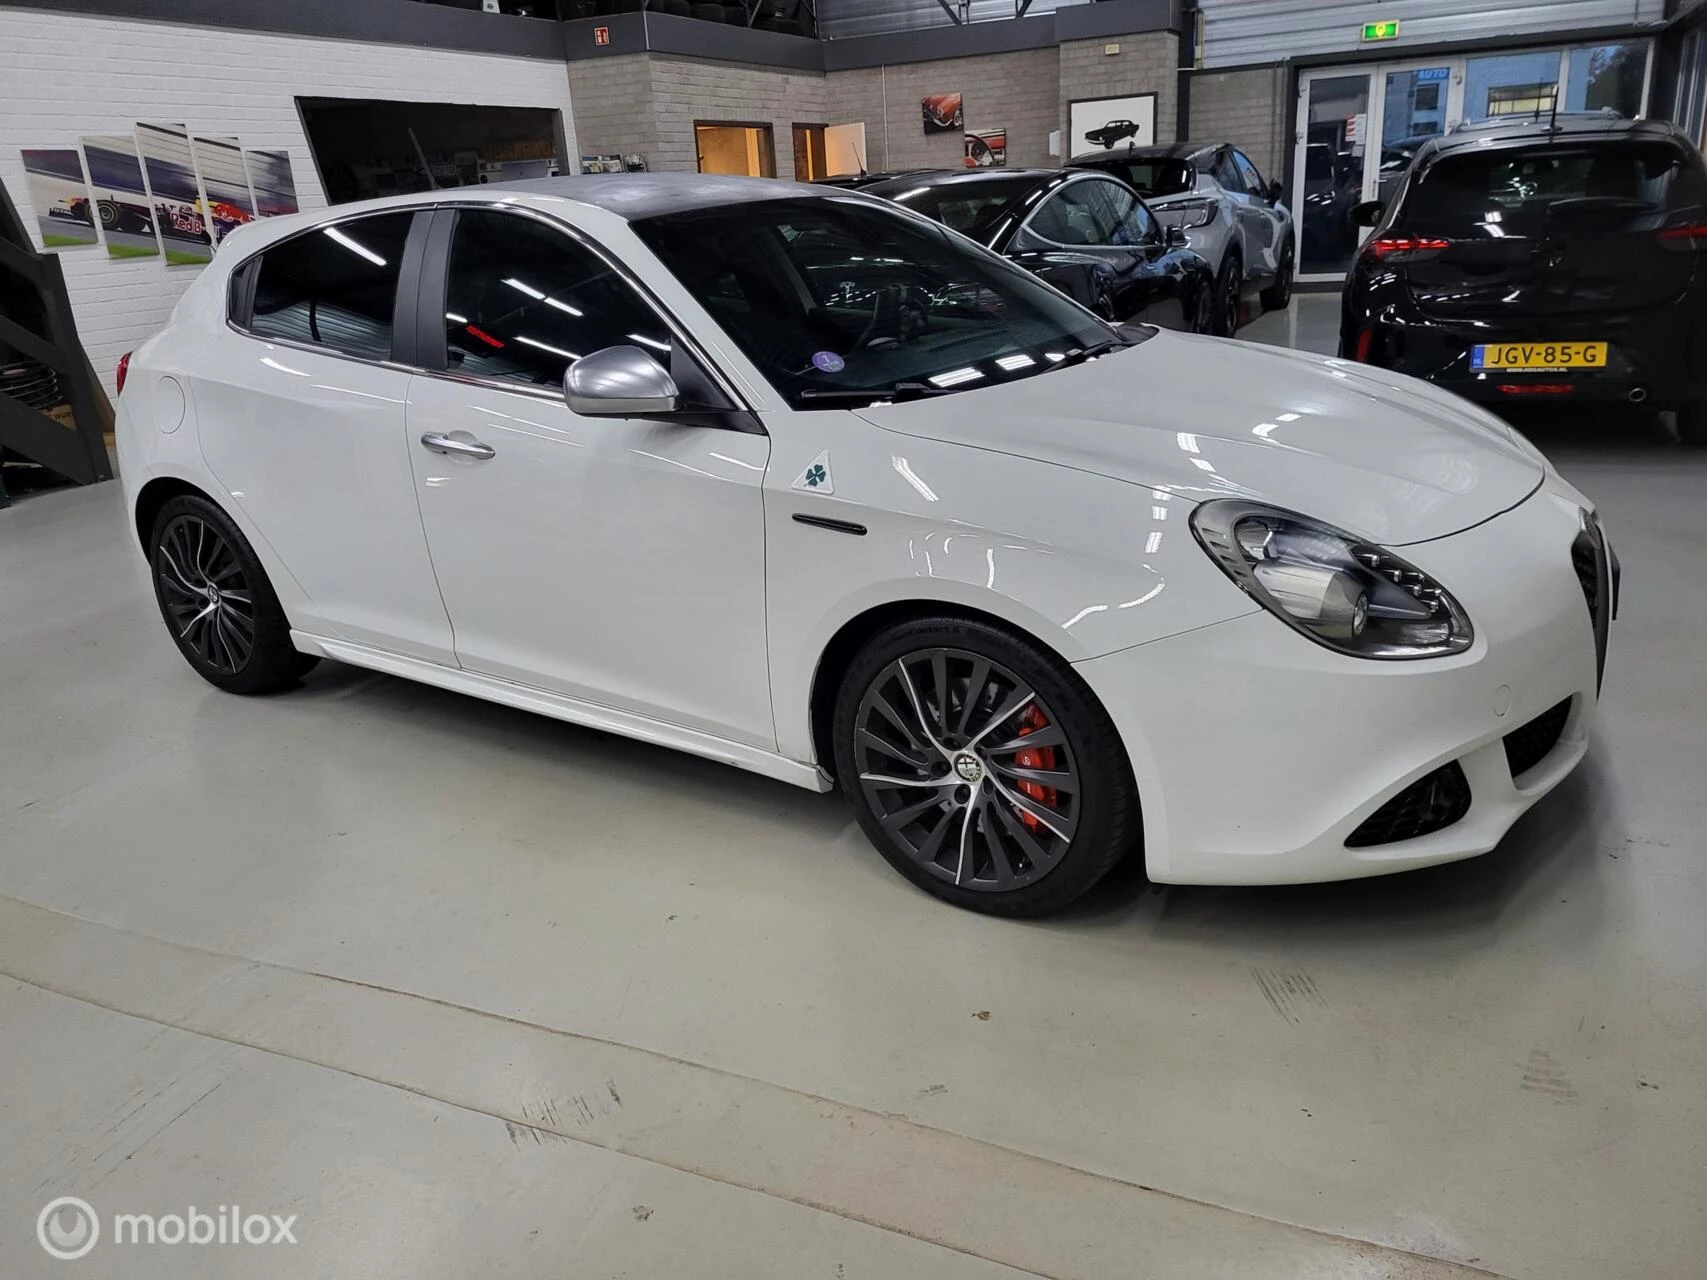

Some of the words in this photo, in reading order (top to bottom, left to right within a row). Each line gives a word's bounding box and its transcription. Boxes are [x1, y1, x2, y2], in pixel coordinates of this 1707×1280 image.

[1418, 69, 1448, 79] AUTO
[171, 211, 194, 232] Red
[1491, 345, 1597, 365] JGV-85-G
